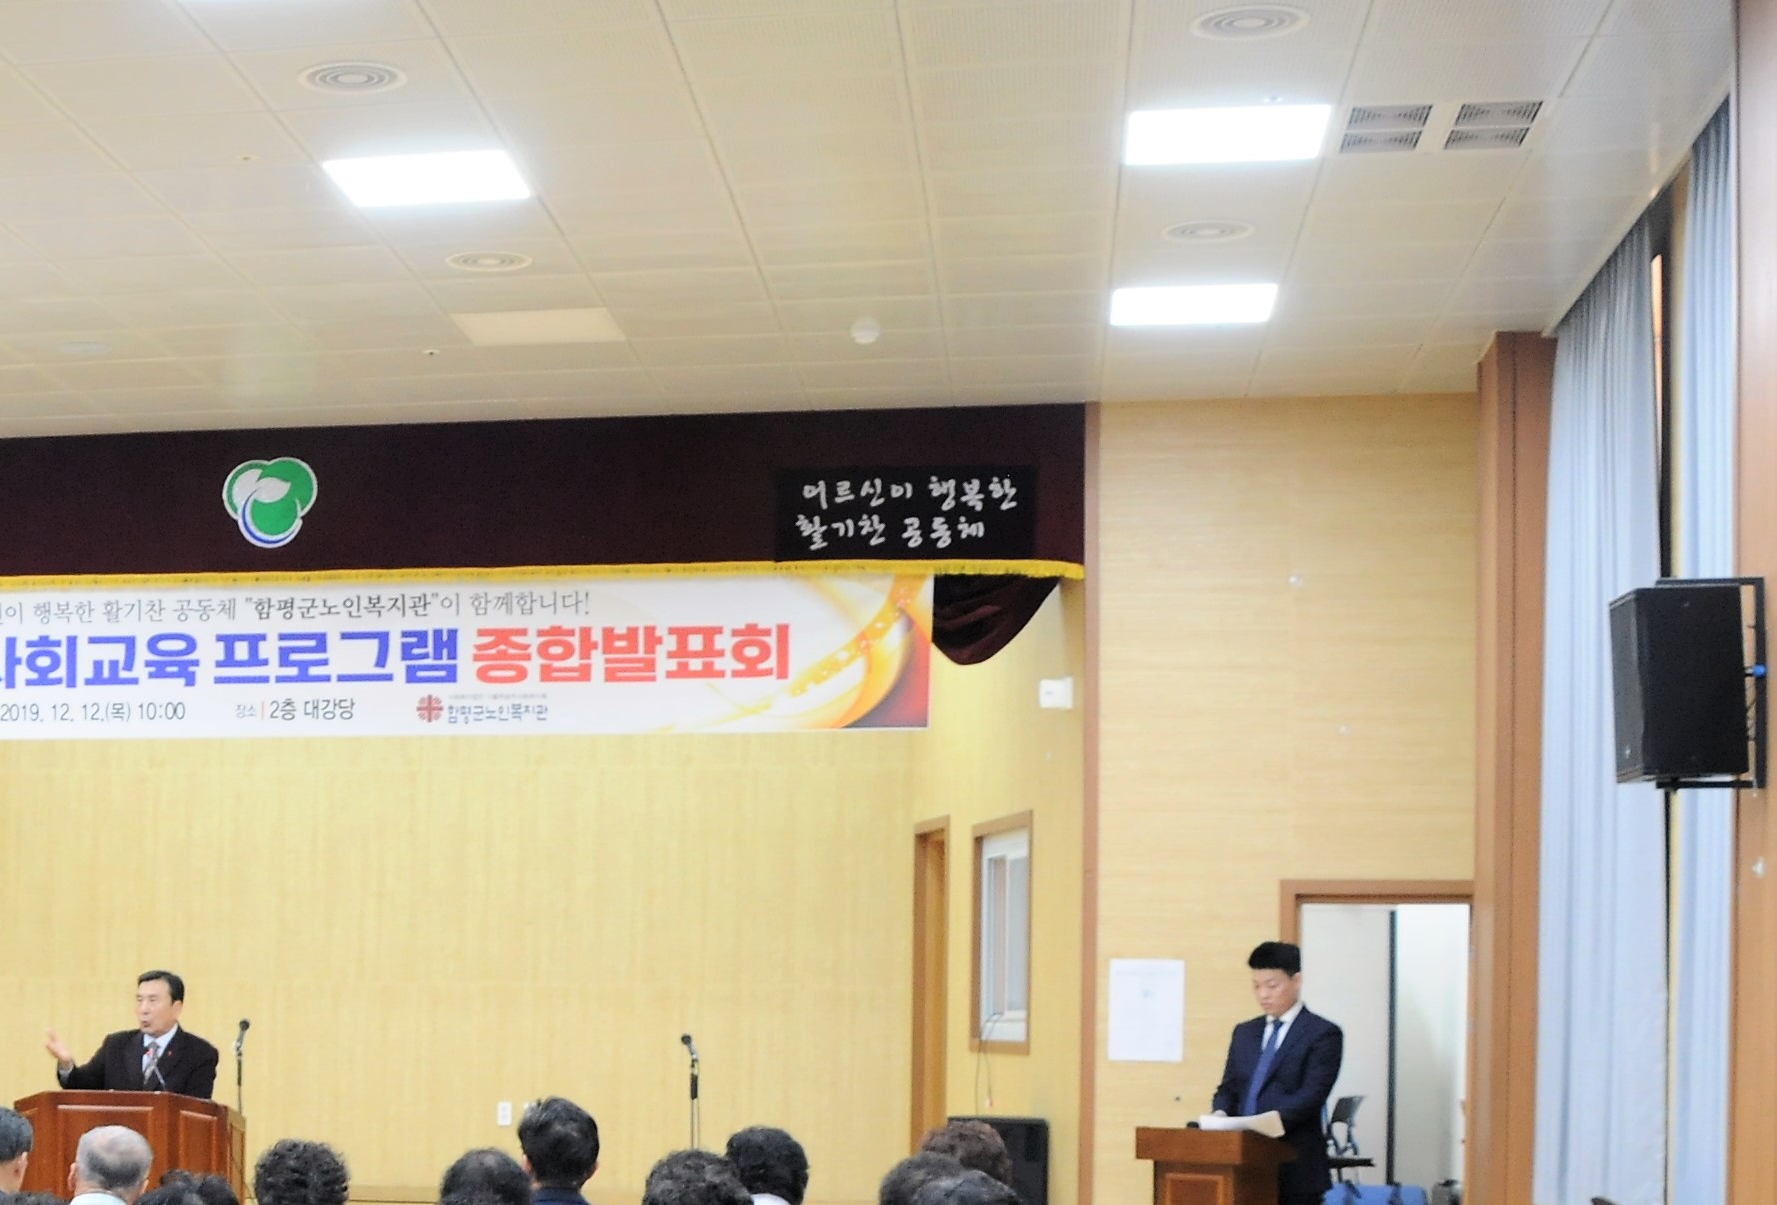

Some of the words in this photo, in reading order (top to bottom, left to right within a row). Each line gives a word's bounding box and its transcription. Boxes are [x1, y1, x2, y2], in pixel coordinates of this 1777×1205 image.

[802, 477, 913, 510] 어르신이
[928, 475, 1018, 511] 행복한
[794, 513, 886, 550] 활기찬
[901, 516, 986, 549] 공동체
[33, 600, 95, 625] 행복한
[102, 599, 166, 624] 활기찬
[172, 597, 237, 623] 공동체
[470, 591, 591, 617] 함께합니다!
[213, 628, 459, 685] 프로그램
[472, 623, 791, 684] 종합발표회
[0, 703, 44, 722] 2019.
[51, 703, 74, 722] 12.
[139, 701, 186, 721] 10:00
[236, 704, 258, 719] 장소
[269, 699, 297, 721] 2층
[303, 698, 355, 722] 대강당
[448, 703, 548, 724] 함평군노인복지관
